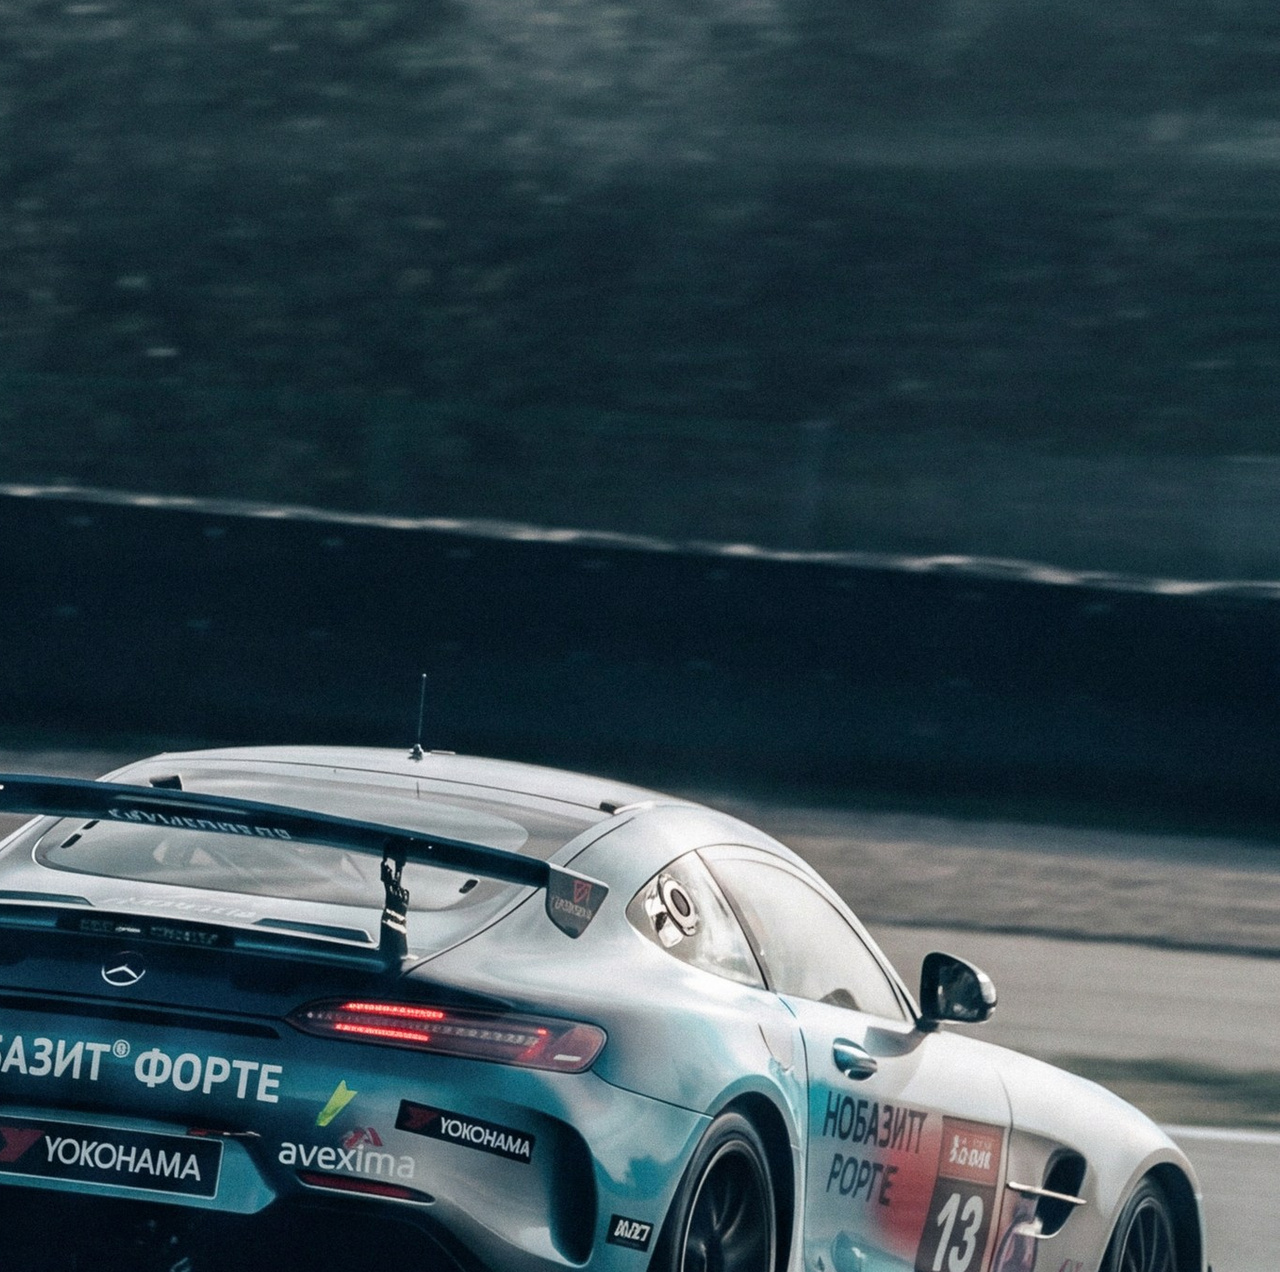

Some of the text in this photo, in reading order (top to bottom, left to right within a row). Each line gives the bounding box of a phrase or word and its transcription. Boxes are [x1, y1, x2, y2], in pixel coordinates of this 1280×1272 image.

[134, 1047, 284, 1104] ФОРТЕ
[44, 1135, 202, 1182] YOKOHAMA
[439, 1116, 531, 1158] YOKOHAMA
[277, 1141, 416, 1179] avexima
